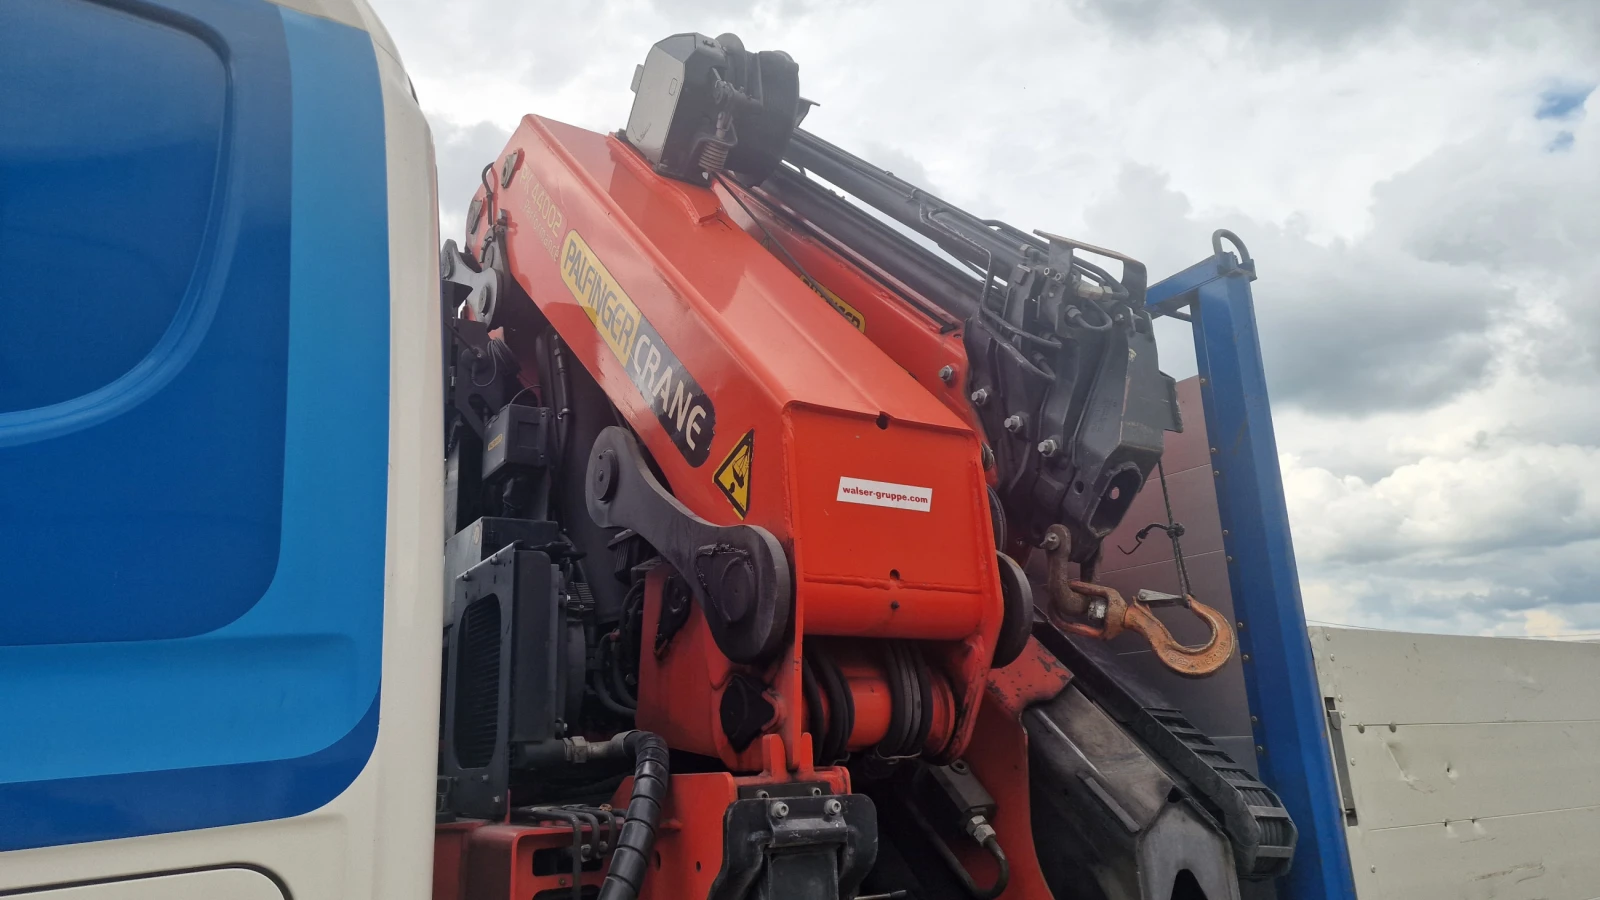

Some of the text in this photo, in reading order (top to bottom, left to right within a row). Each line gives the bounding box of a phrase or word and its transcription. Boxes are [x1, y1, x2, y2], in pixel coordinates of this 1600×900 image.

[520, 167, 562, 238] PK 44002
[522, 198, 561, 262] Performance
[563, 238, 707, 451] PALFINGER CRANE
[842, 486, 929, 504] walser-gruppe.com
